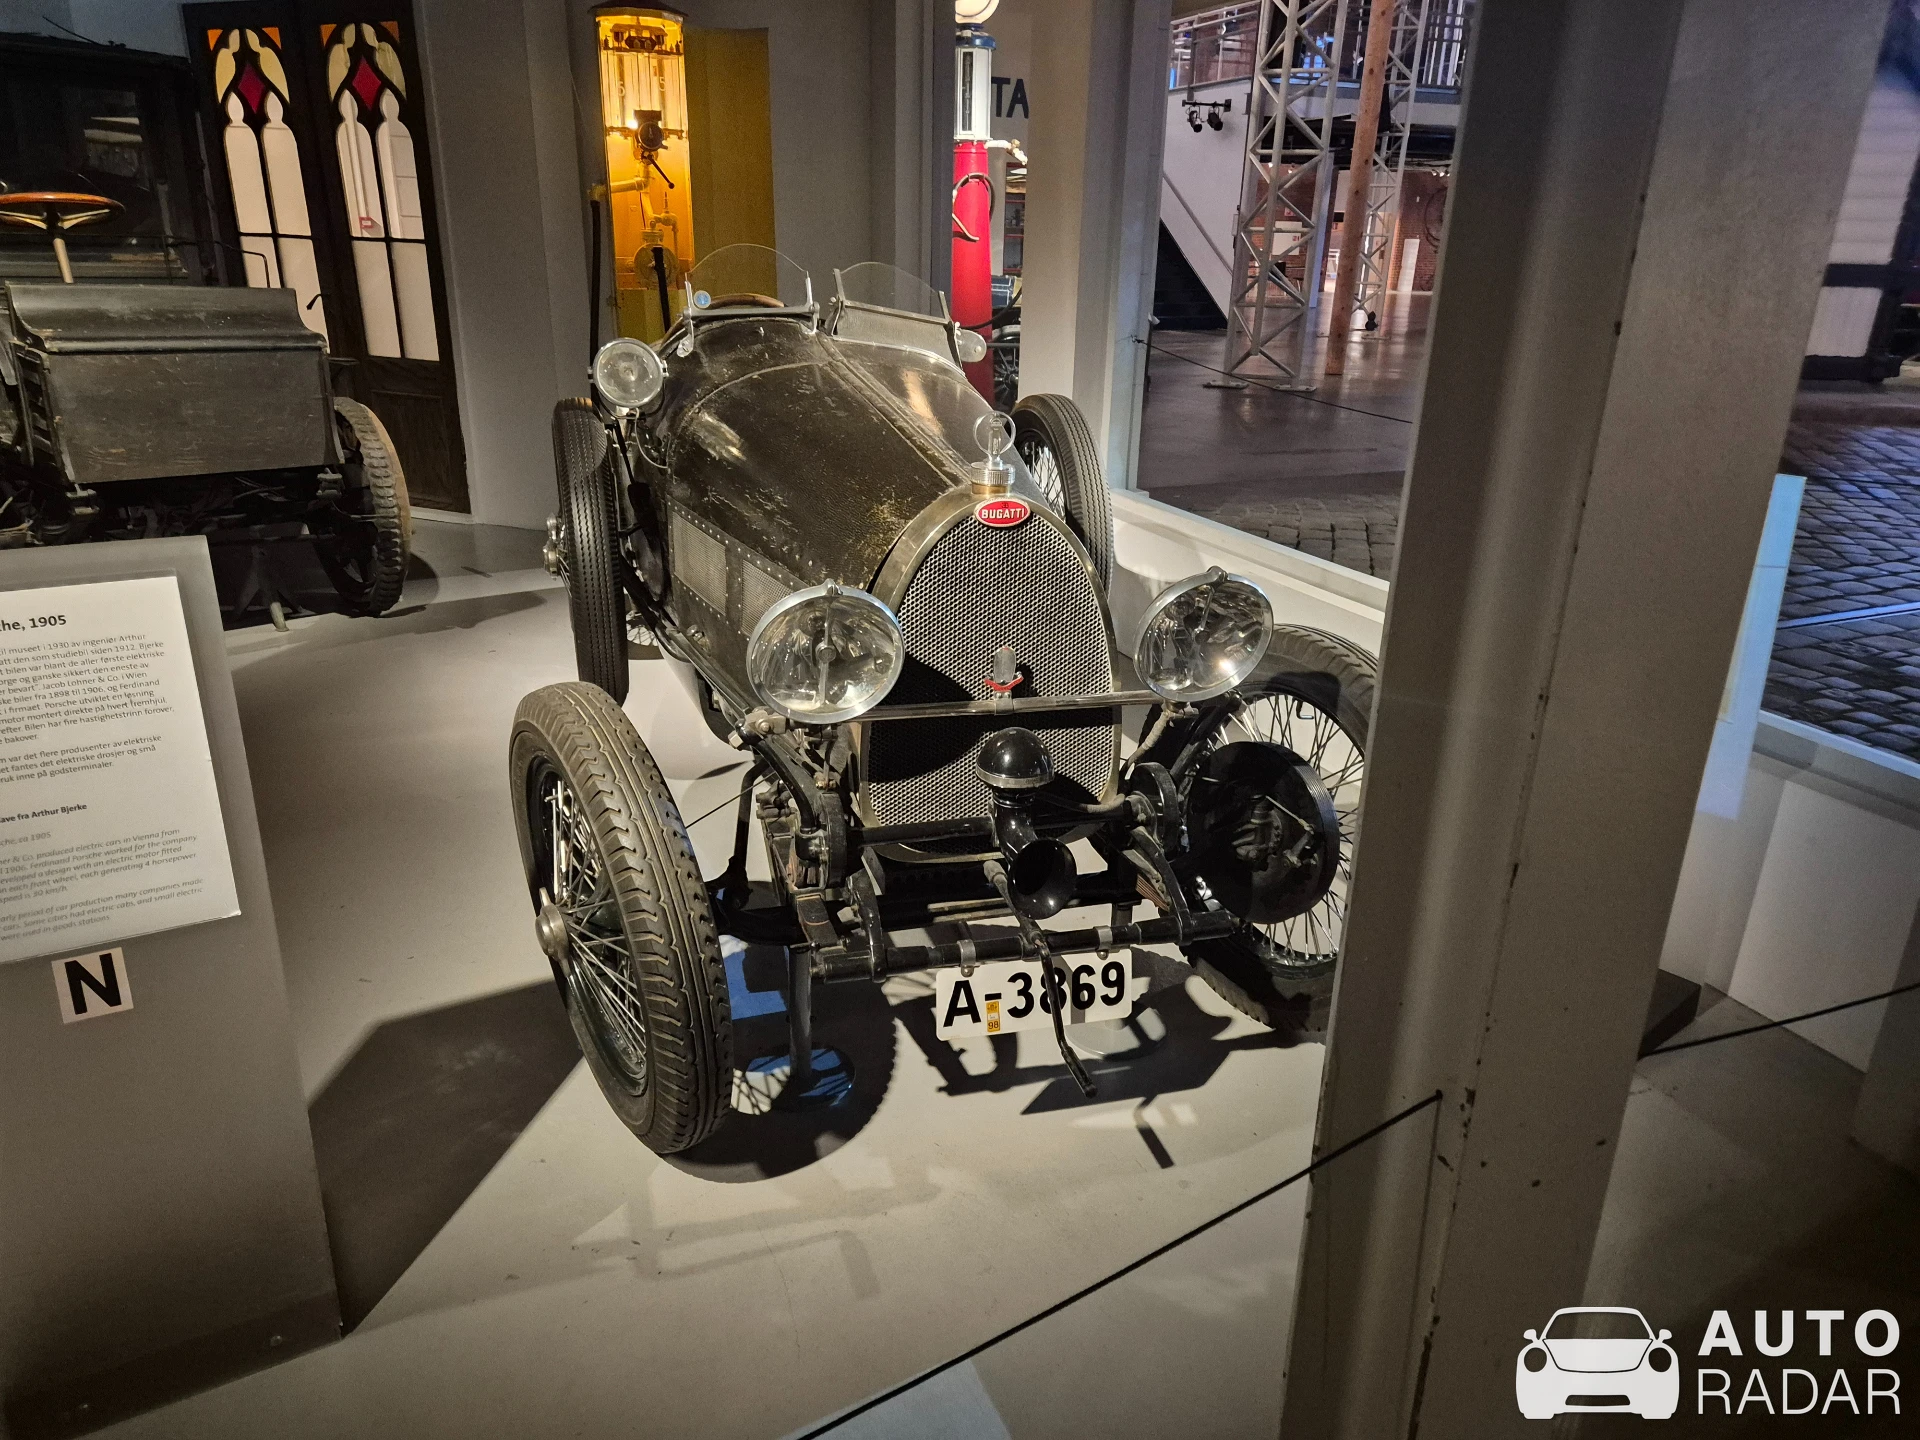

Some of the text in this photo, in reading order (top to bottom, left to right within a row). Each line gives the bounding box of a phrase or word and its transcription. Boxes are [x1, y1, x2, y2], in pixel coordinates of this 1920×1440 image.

[982, 508, 1024, 518] BUGATTI
[0, 614, 67, 631] he, 1905
[48, 641, 70, 650] 1930
[52, 649, 88, 660] studiebil
[90, 648, 112, 656] siden
[139, 641, 164, 650] Bjerke
[6, 667, 27, 675] bilen
[44, 662, 66, 670] blant
[81, 658, 99, 666] aller
[127, 651, 165, 660] elektriske
[32, 672, 61, 683] ganske
[63, 668, 91, 677] sikkert
[93, 667, 108, 675] den
[110, 663, 138, 672] eneste
[14, 695, 32, 703] biler
[49, 690, 70, 699] 1898
[120, 679, 160, 690] Ferdinand
[43, 681, 65, 690] Jacob
[67, 678, 96, 687] Lohner
[125, 672, 148, 680] Wien
[27, 710, 62, 721] montert
[64, 707, 93, 717] direkte
[107, 702, 129, 710] hvert
[45, 699, 77, 709] Porsche
[80, 695, 110, 705] utviklet
[25, 723, 46, 732] Bilen
[48, 720, 61, 728] har
[80, 710, 143, 724] hastighetstrinn
[8, 755, 21, 763] var
[24, 753, 37, 761] det
[61, 743, 110, 756] produsenter
[124, 735, 162, 746] elektriske
[11, 764, 38, 772] fantes
[40, 761, 54, 769] det
[56, 754, 95, 766] elektriske
[97, 750, 125, 760] drosjer
[139, 744, 156, 753] små
[16, 773, 35, 781] inne
[0, 815, 16, 823] ave
[32, 808, 59, 819] Arthur
[60, 803, 87, 814] Bjerke
[31, 832, 51, 842] 1905
[37, 847, 74, 860] produced
[76, 842, 104, 853] electric
[133, 832, 160, 842] Vienna
[161, 829, 180, 838] from
[30, 856, 70, 869] Ferdinand
[73, 851, 103, 862] Porsche
[104, 845, 132, 856] worked
[134, 844, 146, 852] for
[148, 841, 161, 849] the
[162, 835, 198, 847] company
[45, 866, 72, 877] design
[73, 861, 92, 871] with
[106, 855, 133, 865] electric
[135, 851, 160, 860] motor
[161, 846, 182, 857] fitted
[9, 883, 29, 893] each
[30, 879, 50, 890] front
[80, 869, 99, 880] each
[101, 862, 143, 877] generating
[70, 895, 113, 910] production
[115, 891, 137, 900] many
[140, 883, 180, 896] companies
[182, 879, 203, 887] made
[70, 910, 85, 918] had
[87, 904, 115, 914] electric
[137, 897, 152, 905] and
[154, 892, 175, 902] small
[177, 888, 204, 898] electric
[64, 953, 122, 1015] N
[988, 1021, 998, 1029] 98
